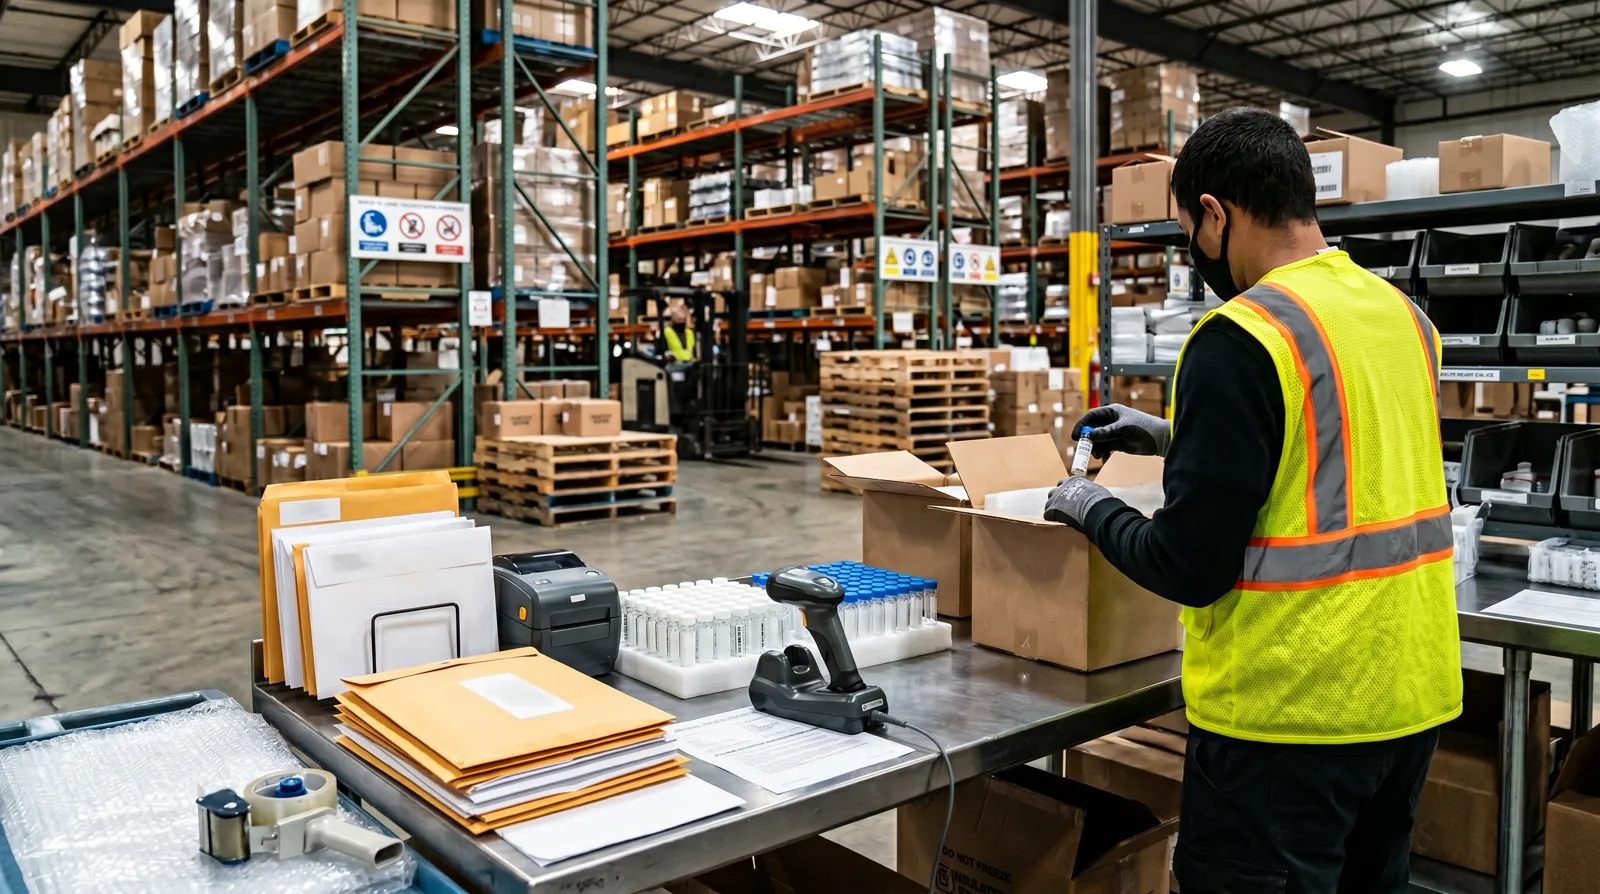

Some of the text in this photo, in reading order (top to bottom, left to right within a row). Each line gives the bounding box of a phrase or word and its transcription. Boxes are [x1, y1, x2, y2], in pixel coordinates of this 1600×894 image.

[942, 845, 1012, 885] DO NOT FREEZE
